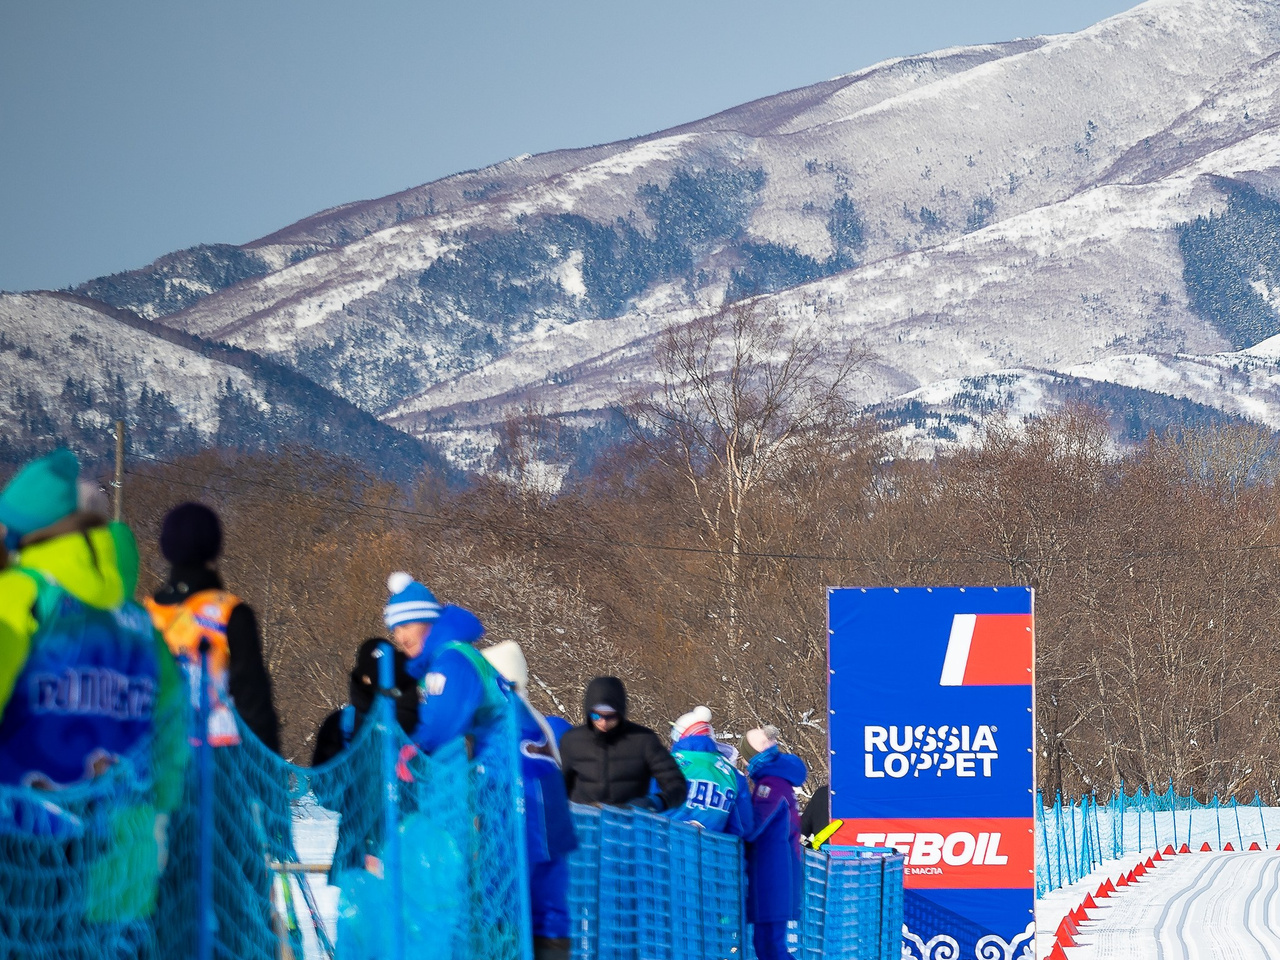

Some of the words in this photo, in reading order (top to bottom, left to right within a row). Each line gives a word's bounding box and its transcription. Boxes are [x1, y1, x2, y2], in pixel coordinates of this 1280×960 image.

[864, 725, 998, 752] RUSSIA
[864, 752, 998, 778] LOPPET
[856, 831, 1009, 866] TEBOIL
[911, 867, 943, 875] МАСЛА
